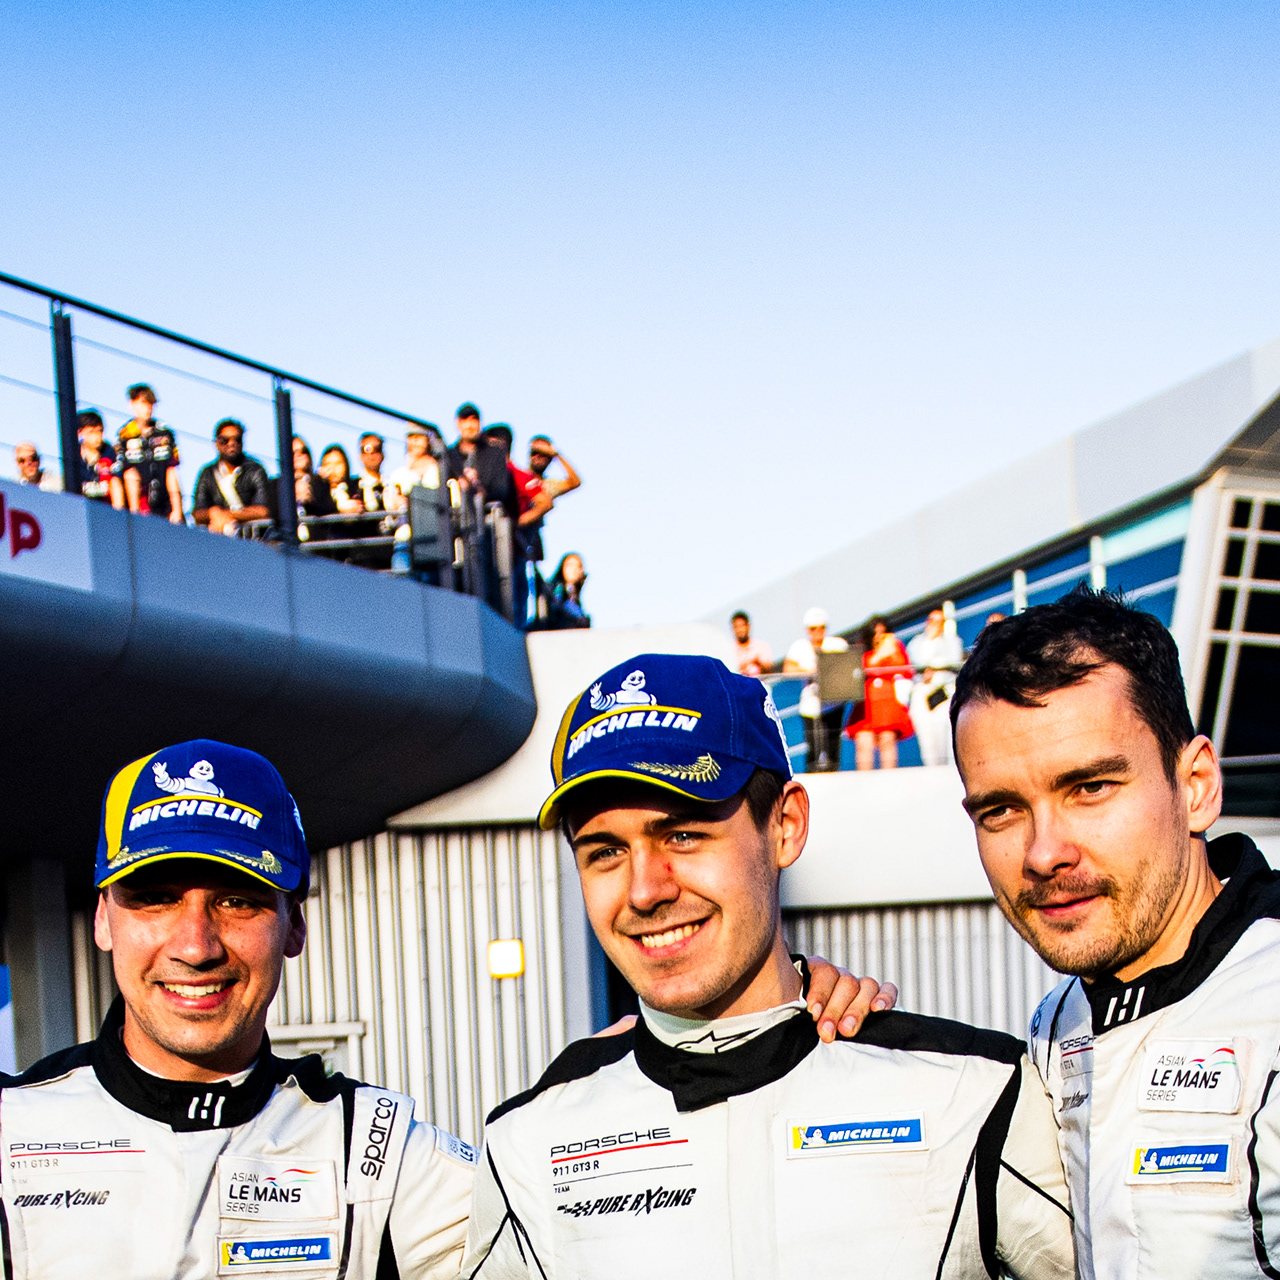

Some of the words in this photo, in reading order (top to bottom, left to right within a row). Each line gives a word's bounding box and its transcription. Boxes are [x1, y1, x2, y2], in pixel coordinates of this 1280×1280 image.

[567, 711, 699, 759] MICHELIN
[129, 799, 262, 831] MICHELIN
[1157, 1055, 1186, 1067] ASIAN
[1150, 1069, 1171, 1087] LE
[1173, 1070, 1221, 1089] MANS
[1146, 1089, 1176, 1102] SERIES
[361, 1096, 399, 1181] sparco
[828, 1126, 910, 1142] MICHELIN
[10, 1138, 131, 1153] PORSCHE
[551, 1127, 671, 1158] PORSCHE
[10, 1159, 29, 1169] 911
[31, 1159, 50, 1168] GT3
[53, 1158, 60, 1167] R
[1159, 1152, 1219, 1167] MICHELIN
[552, 1164, 570, 1177] 911
[572, 1160, 591, 1174] GT3
[593, 1159, 600, 1171] R
[231, 1172, 259, 1183] ASIAN
[229, 1184, 249, 1200] LE
[254, 1188, 302, 1203] MANS
[554, 1185, 570, 1194] TEAM
[13, 1193, 49, 1208] PURE
[225, 1201, 260, 1214] SERIES
[590, 1193, 629, 1216] PURE
[250, 1244, 322, 1259] MICHELIN
